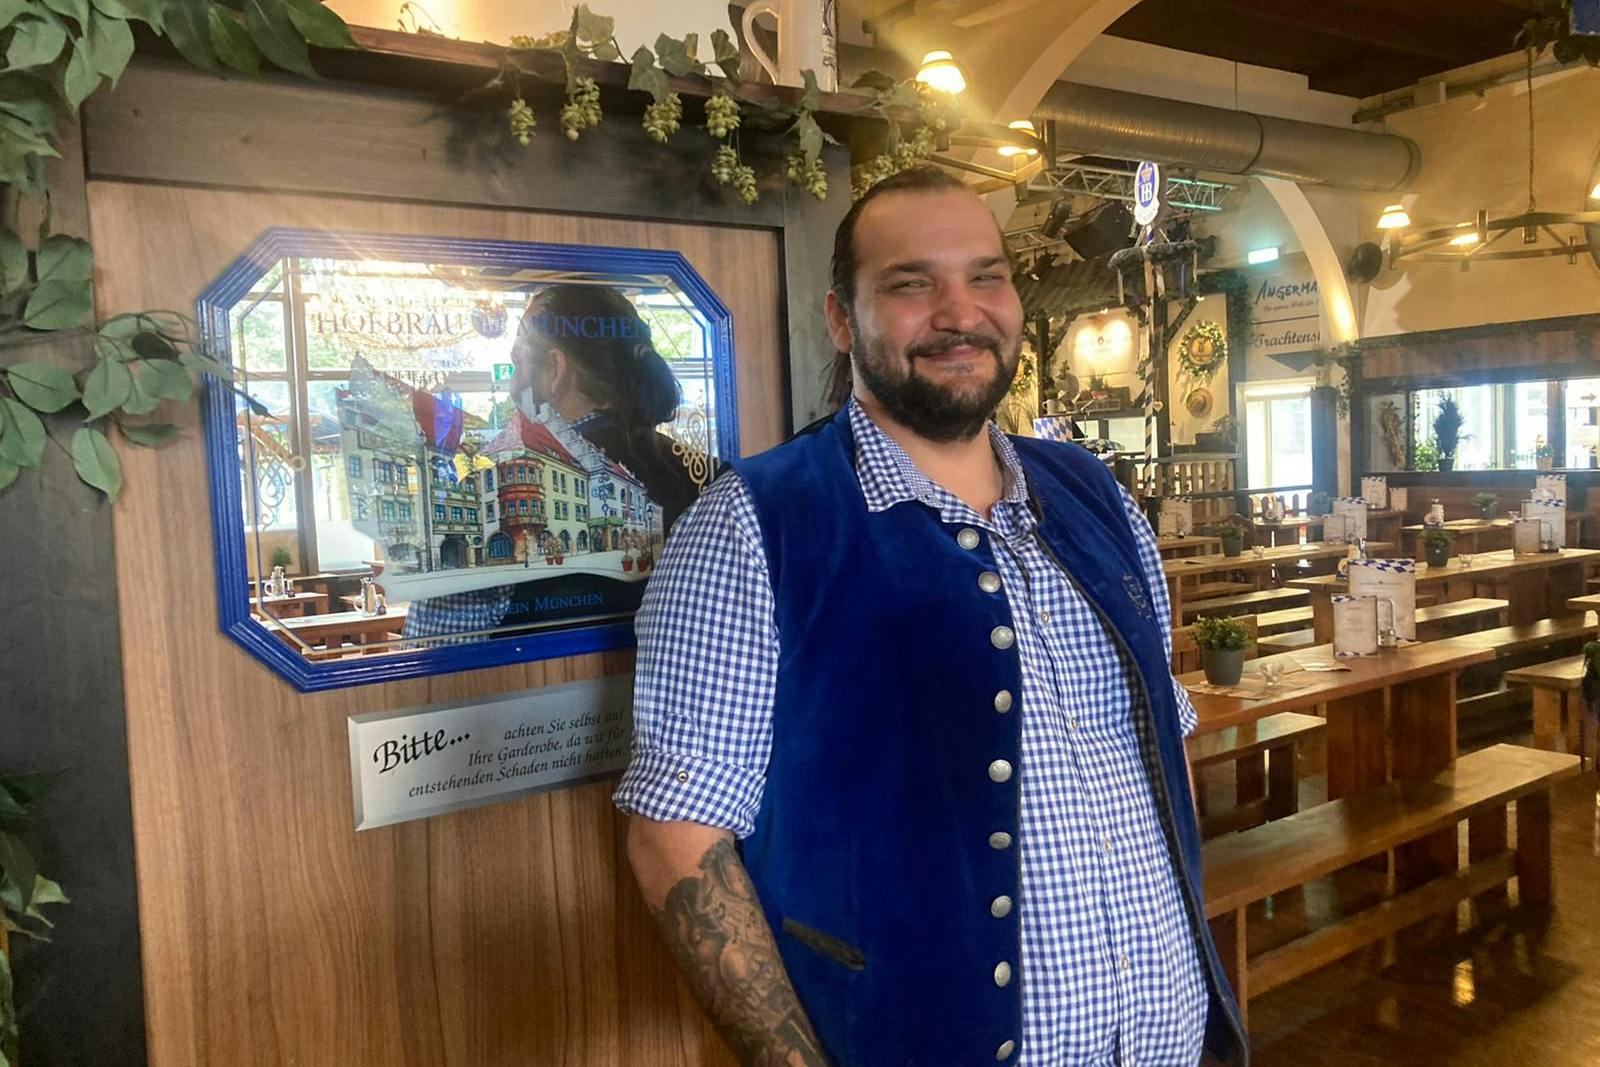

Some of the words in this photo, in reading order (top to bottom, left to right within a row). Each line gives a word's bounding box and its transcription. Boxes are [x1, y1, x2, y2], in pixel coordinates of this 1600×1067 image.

[1254, 280, 1318, 306] ANGERMA
[316, 306, 464, 336] HOFBRÄU
[516, 313, 652, 339] MÜNCHEN
[534, 592, 604, 613] MÜNCHEN
[504, 722, 544, 740] achten
[547, 718, 566, 735] Sie
[568, 711, 601, 729] selbst
[604, 707, 625, 725] auf
[373, 729, 470, 774] Bitte...
[468, 750, 494, 767] Ihre
[497, 736, 563, 766] Garderobe,
[566, 732, 581, 748] da
[584, 730, 605, 745] wir
[607, 726, 627, 742] für
[409, 769, 493, 797] entstehenden
[496, 760, 548, 782] Schaden
[552, 751, 581, 770] nicht
